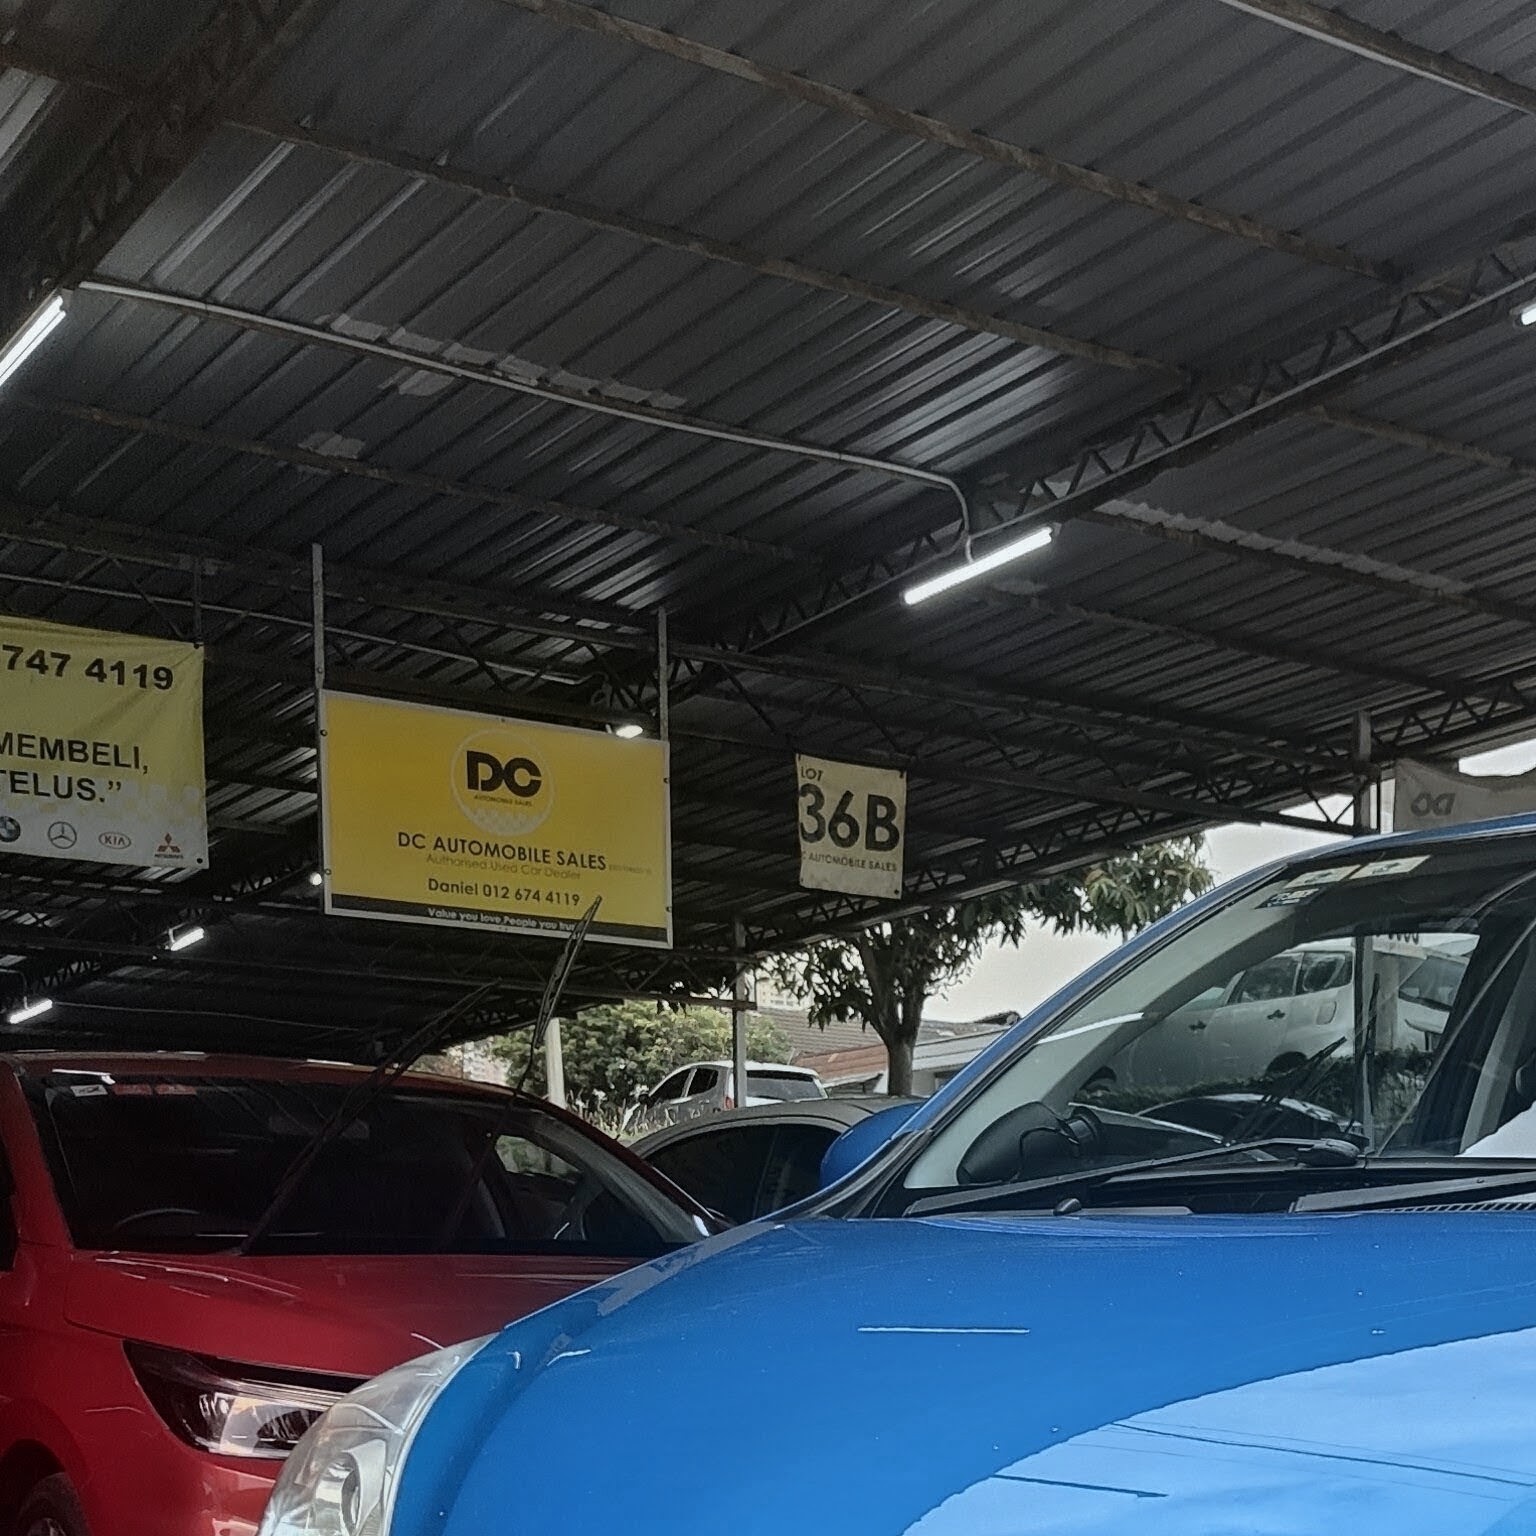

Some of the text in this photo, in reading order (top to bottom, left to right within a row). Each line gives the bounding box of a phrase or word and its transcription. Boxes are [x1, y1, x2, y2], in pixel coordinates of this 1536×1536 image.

[2, 644, 174, 690] 747 4119
[466, 750, 542, 798] DC
[801, 766, 824, 781] LOT
[800, 783, 900, 852] 36B
[104, 834, 126, 847] KIA
[398, 832, 426, 849] DC
[433, 836, 551, 864] AUTOMOBILE
[557, 850, 606, 870] SALES
[521, 864, 541, 876] Car
[868, 860, 898, 872] SALES
[428, 878, 580, 906] Daniel 012 674 4119
[427, 908, 457, 919] Value
[460, 913, 479, 921] you
[503, 916, 537, 928] People
[540, 921, 558, 930] you
